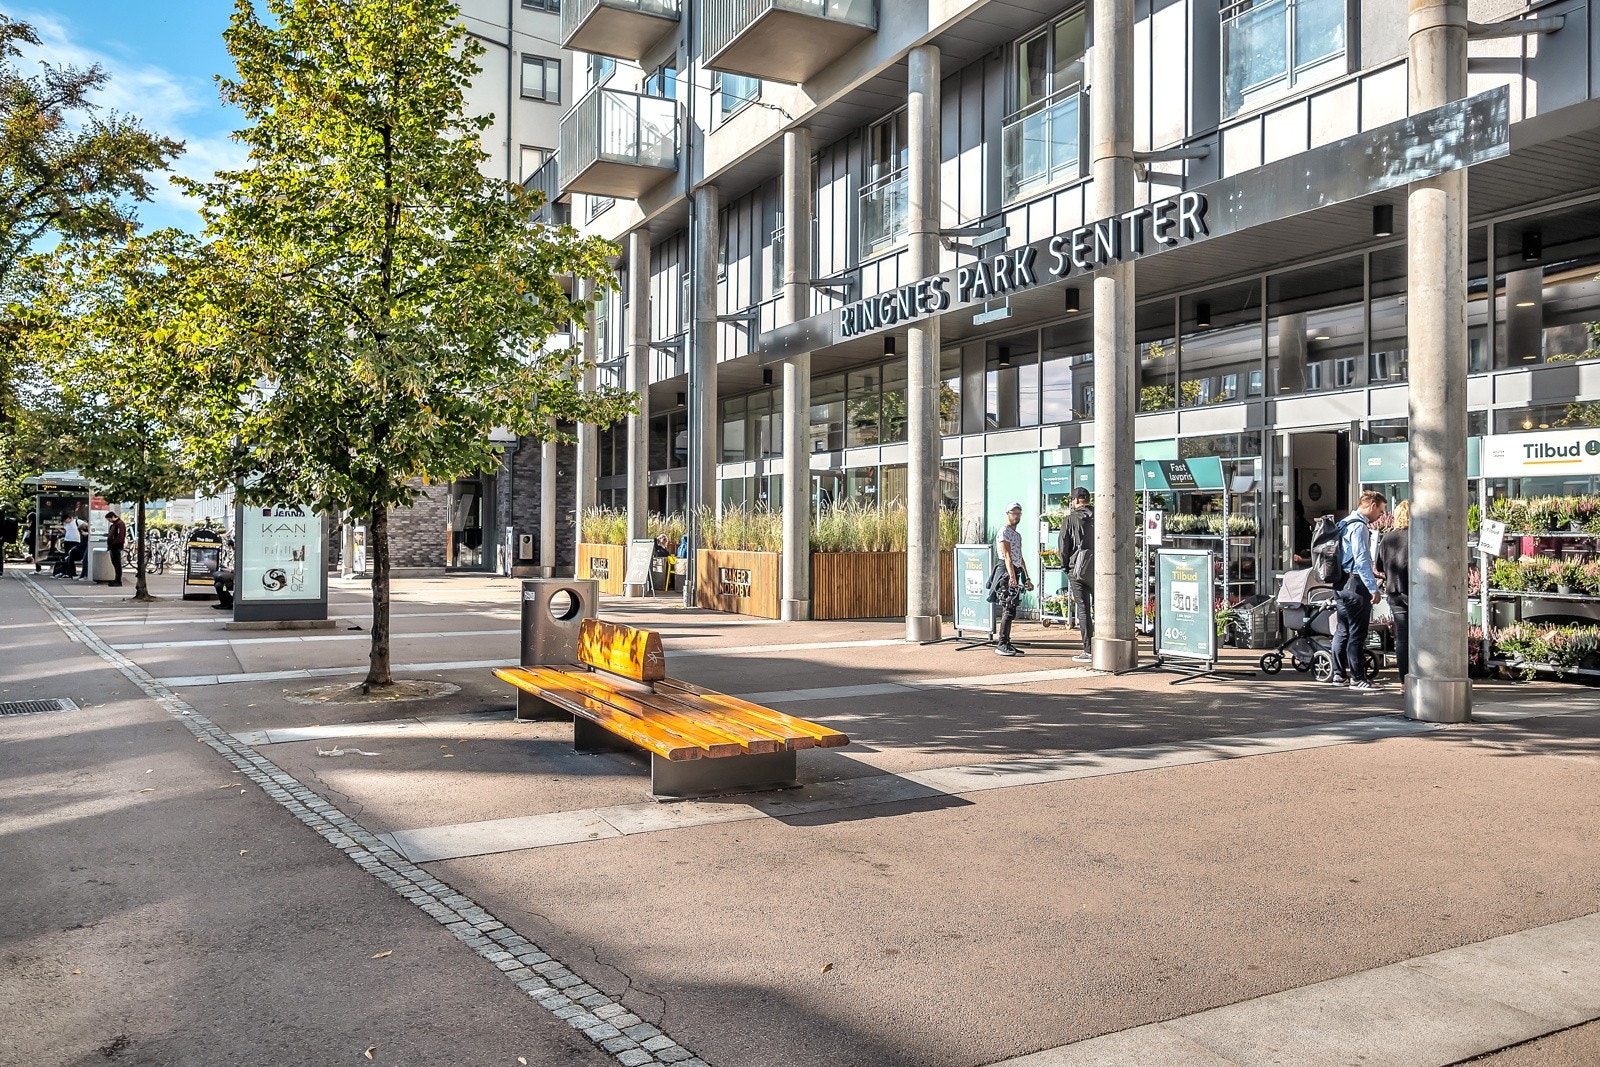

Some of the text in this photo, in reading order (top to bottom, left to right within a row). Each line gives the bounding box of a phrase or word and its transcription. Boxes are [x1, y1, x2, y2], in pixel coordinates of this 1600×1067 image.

[840, 191, 1208, 337] RINGNES PARK SENTER
[1523, 441, 1580, 459] Tilbud
[1170, 463, 1187, 472] Fast
[1169, 473, 1193, 483] lavpris
[261, 523, 306, 534] KAN
[724, 569, 749, 583] BAKER
[1172, 571, 1198, 581] Tilbud
[719, 582, 750, 598] NORDBY
[961, 606, 976, 617] 40%
[1164, 627, 1187, 641] 40%
